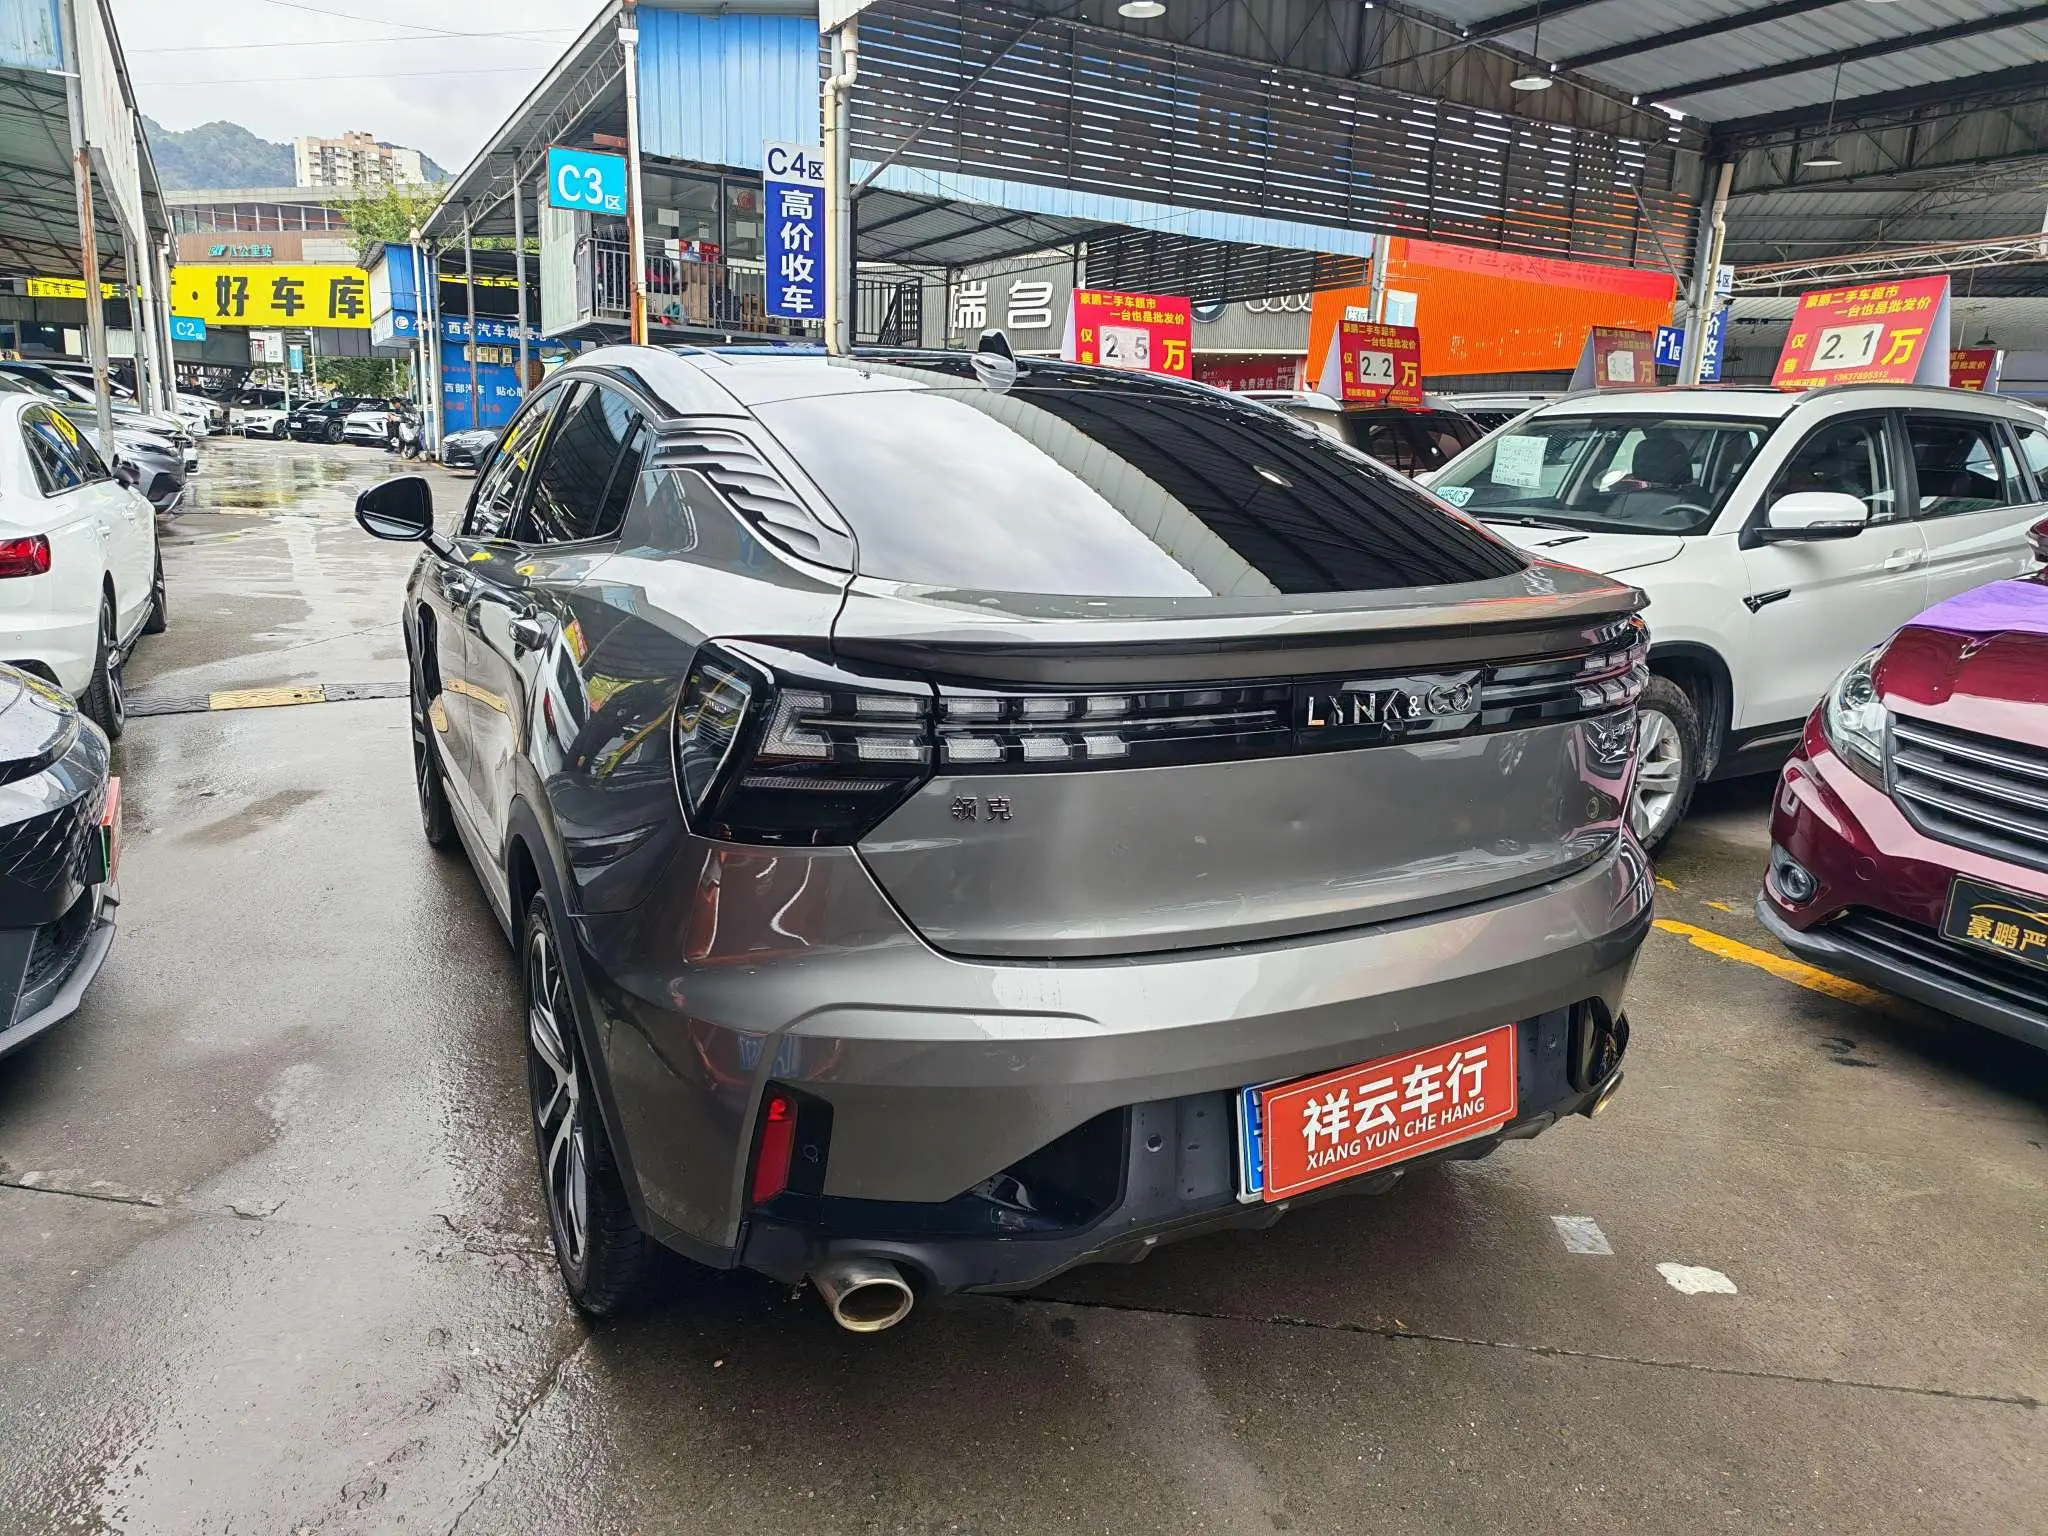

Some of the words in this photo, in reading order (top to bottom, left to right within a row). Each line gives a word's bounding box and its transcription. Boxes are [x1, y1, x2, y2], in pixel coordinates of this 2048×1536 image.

[768, 148, 824, 180] C4区
[558, 164, 621, 210] C3区
[780, 189, 815, 314] 高价收车
[1110, 309, 1185, 325] 一台也是批发价
[1834, 296, 1931, 318] 一台也是批发价
[1105, 333, 1147, 360] 2.5
[1162, 339, 1187, 371] 万
[1656, 329, 1681, 361] F1区
[1820, 328, 1875, 361] 2.1
[1880, 328, 1924, 366] 万
[1361, 356, 1392, 378] 2.2
[1401, 361, 1418, 387] 万
[952, 796, 1014, 821] 领克
[1302, 1046, 1488, 1152] 祥云车行
[1306, 1141, 1361, 1171] XIANG
[1365, 1127, 1401, 1152] YUN
[1404, 1112, 1436, 1138] CHE
[1441, 1096, 1485, 1125] HANG
